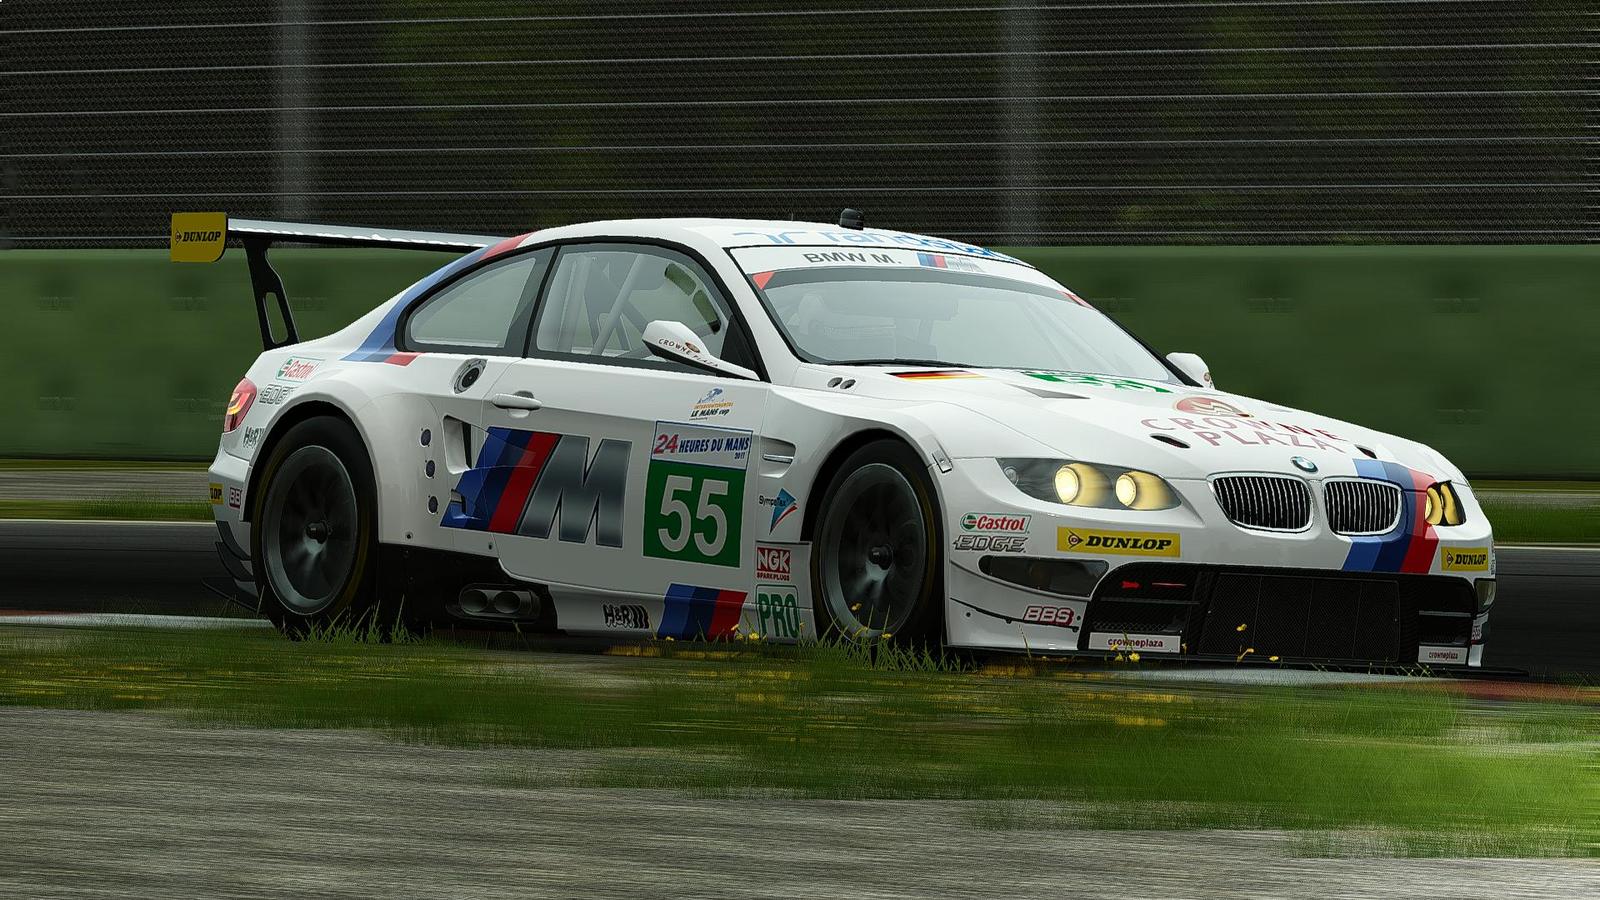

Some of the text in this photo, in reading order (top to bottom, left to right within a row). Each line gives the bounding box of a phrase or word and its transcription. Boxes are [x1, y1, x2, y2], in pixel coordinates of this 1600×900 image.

[183, 231, 221, 242] DUNLOP
[803, 252, 867, 263] BMW
[658, 338, 719, 367] CROWNE PLAZA
[699, 408, 719, 417] MANS
[1140, 417, 1348, 441] CROWNE
[653, 433, 750, 455] 24 HEURES DU MANS
[1193, 431, 1346, 453] PLAZA
[516, 434, 632, 548] M
[657, 474, 729, 557] 55
[976, 515, 1025, 531] Castrol
[953, 534, 1028, 552] EDGE
[1086, 535, 1173, 550] DUNLOP
[757, 549, 790, 572] NGK
[1455, 553, 1487, 566] DUNLOP
[758, 593, 799, 638] PRO
[1023, 606, 1074, 626] BBS
[1108, 638, 1164, 649] crowneplaza
